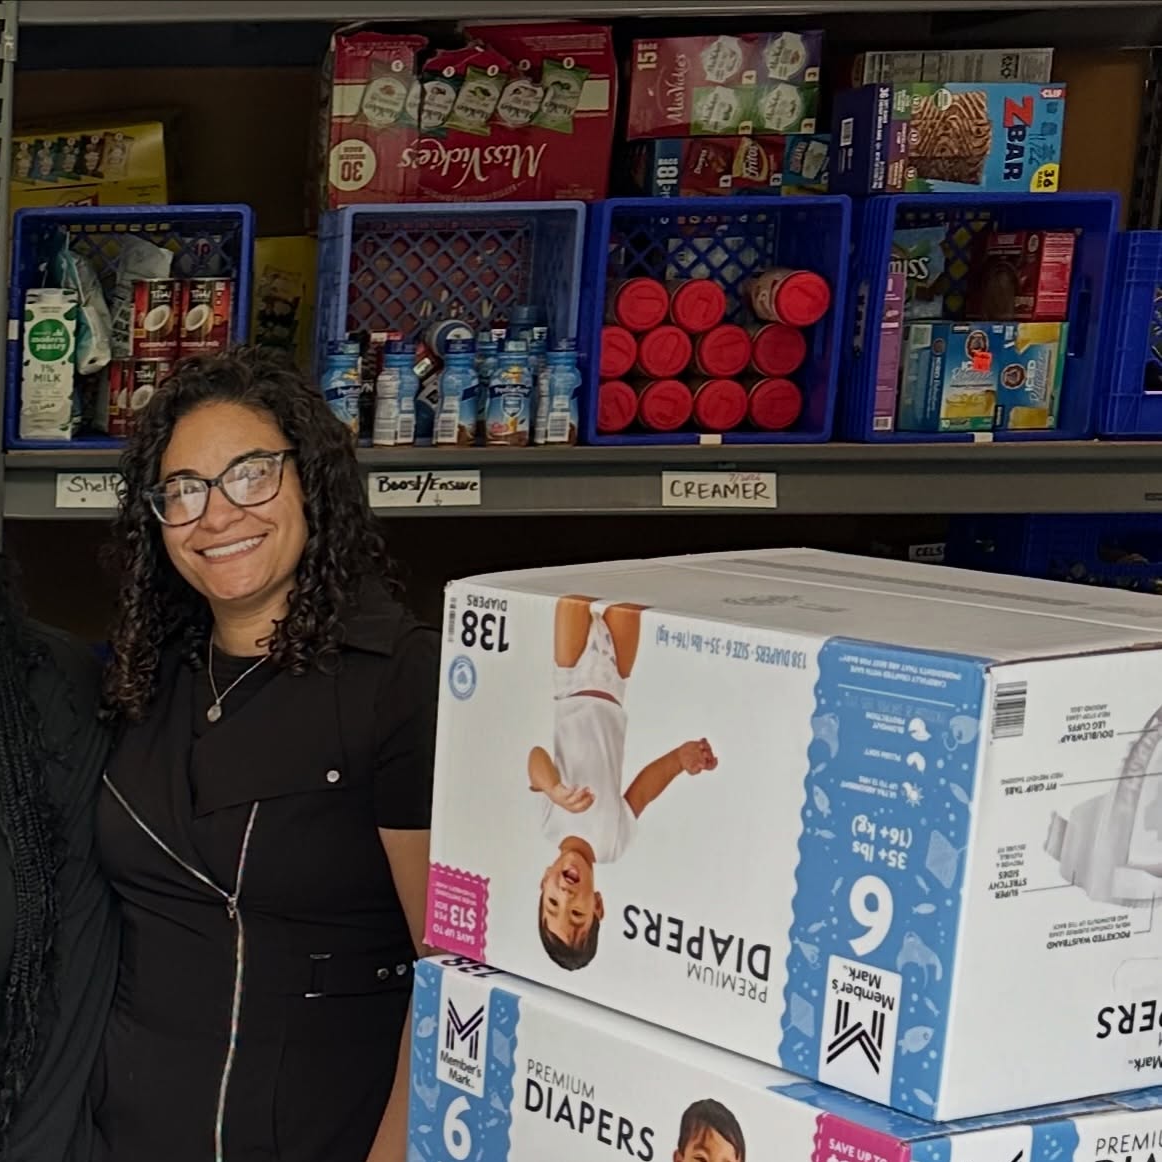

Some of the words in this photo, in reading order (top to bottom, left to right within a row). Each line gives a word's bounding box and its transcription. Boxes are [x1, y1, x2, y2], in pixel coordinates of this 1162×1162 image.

[638, 51, 658, 71] 15
[341, 161, 364, 182] 30
[396, 138, 488, 189] Vickie's
[483, 143, 547, 178] Miss
[657, 165, 679, 185] 18
[1044, 169, 1055, 188] 36
[33, 374, 61, 383] MILK
[670, 480, 770, 500] CREAMER
[466, 594, 508, 612] DIAPERS
[461, 608, 511, 654] 138
[852, 840, 874, 863] lbs
[877, 845, 907, 870] 35+
[849, 874, 894, 957] 6
[623, 903, 772, 982] DIAPERS
[687, 960, 769, 1004] PREMIUM
[832, 977, 896, 1011] Member's
[440, 1049, 483, 1079] Member's
[448, 1067, 473, 1088] Mark
[527, 1058, 596, 1101] PREMIUM
[442, 1095, 472, 1161] 6
[524, 1078, 656, 1162] DIAPERS
[829, 1138, 856, 1158] SAVE
[857, 1149, 872, 1162] UP
